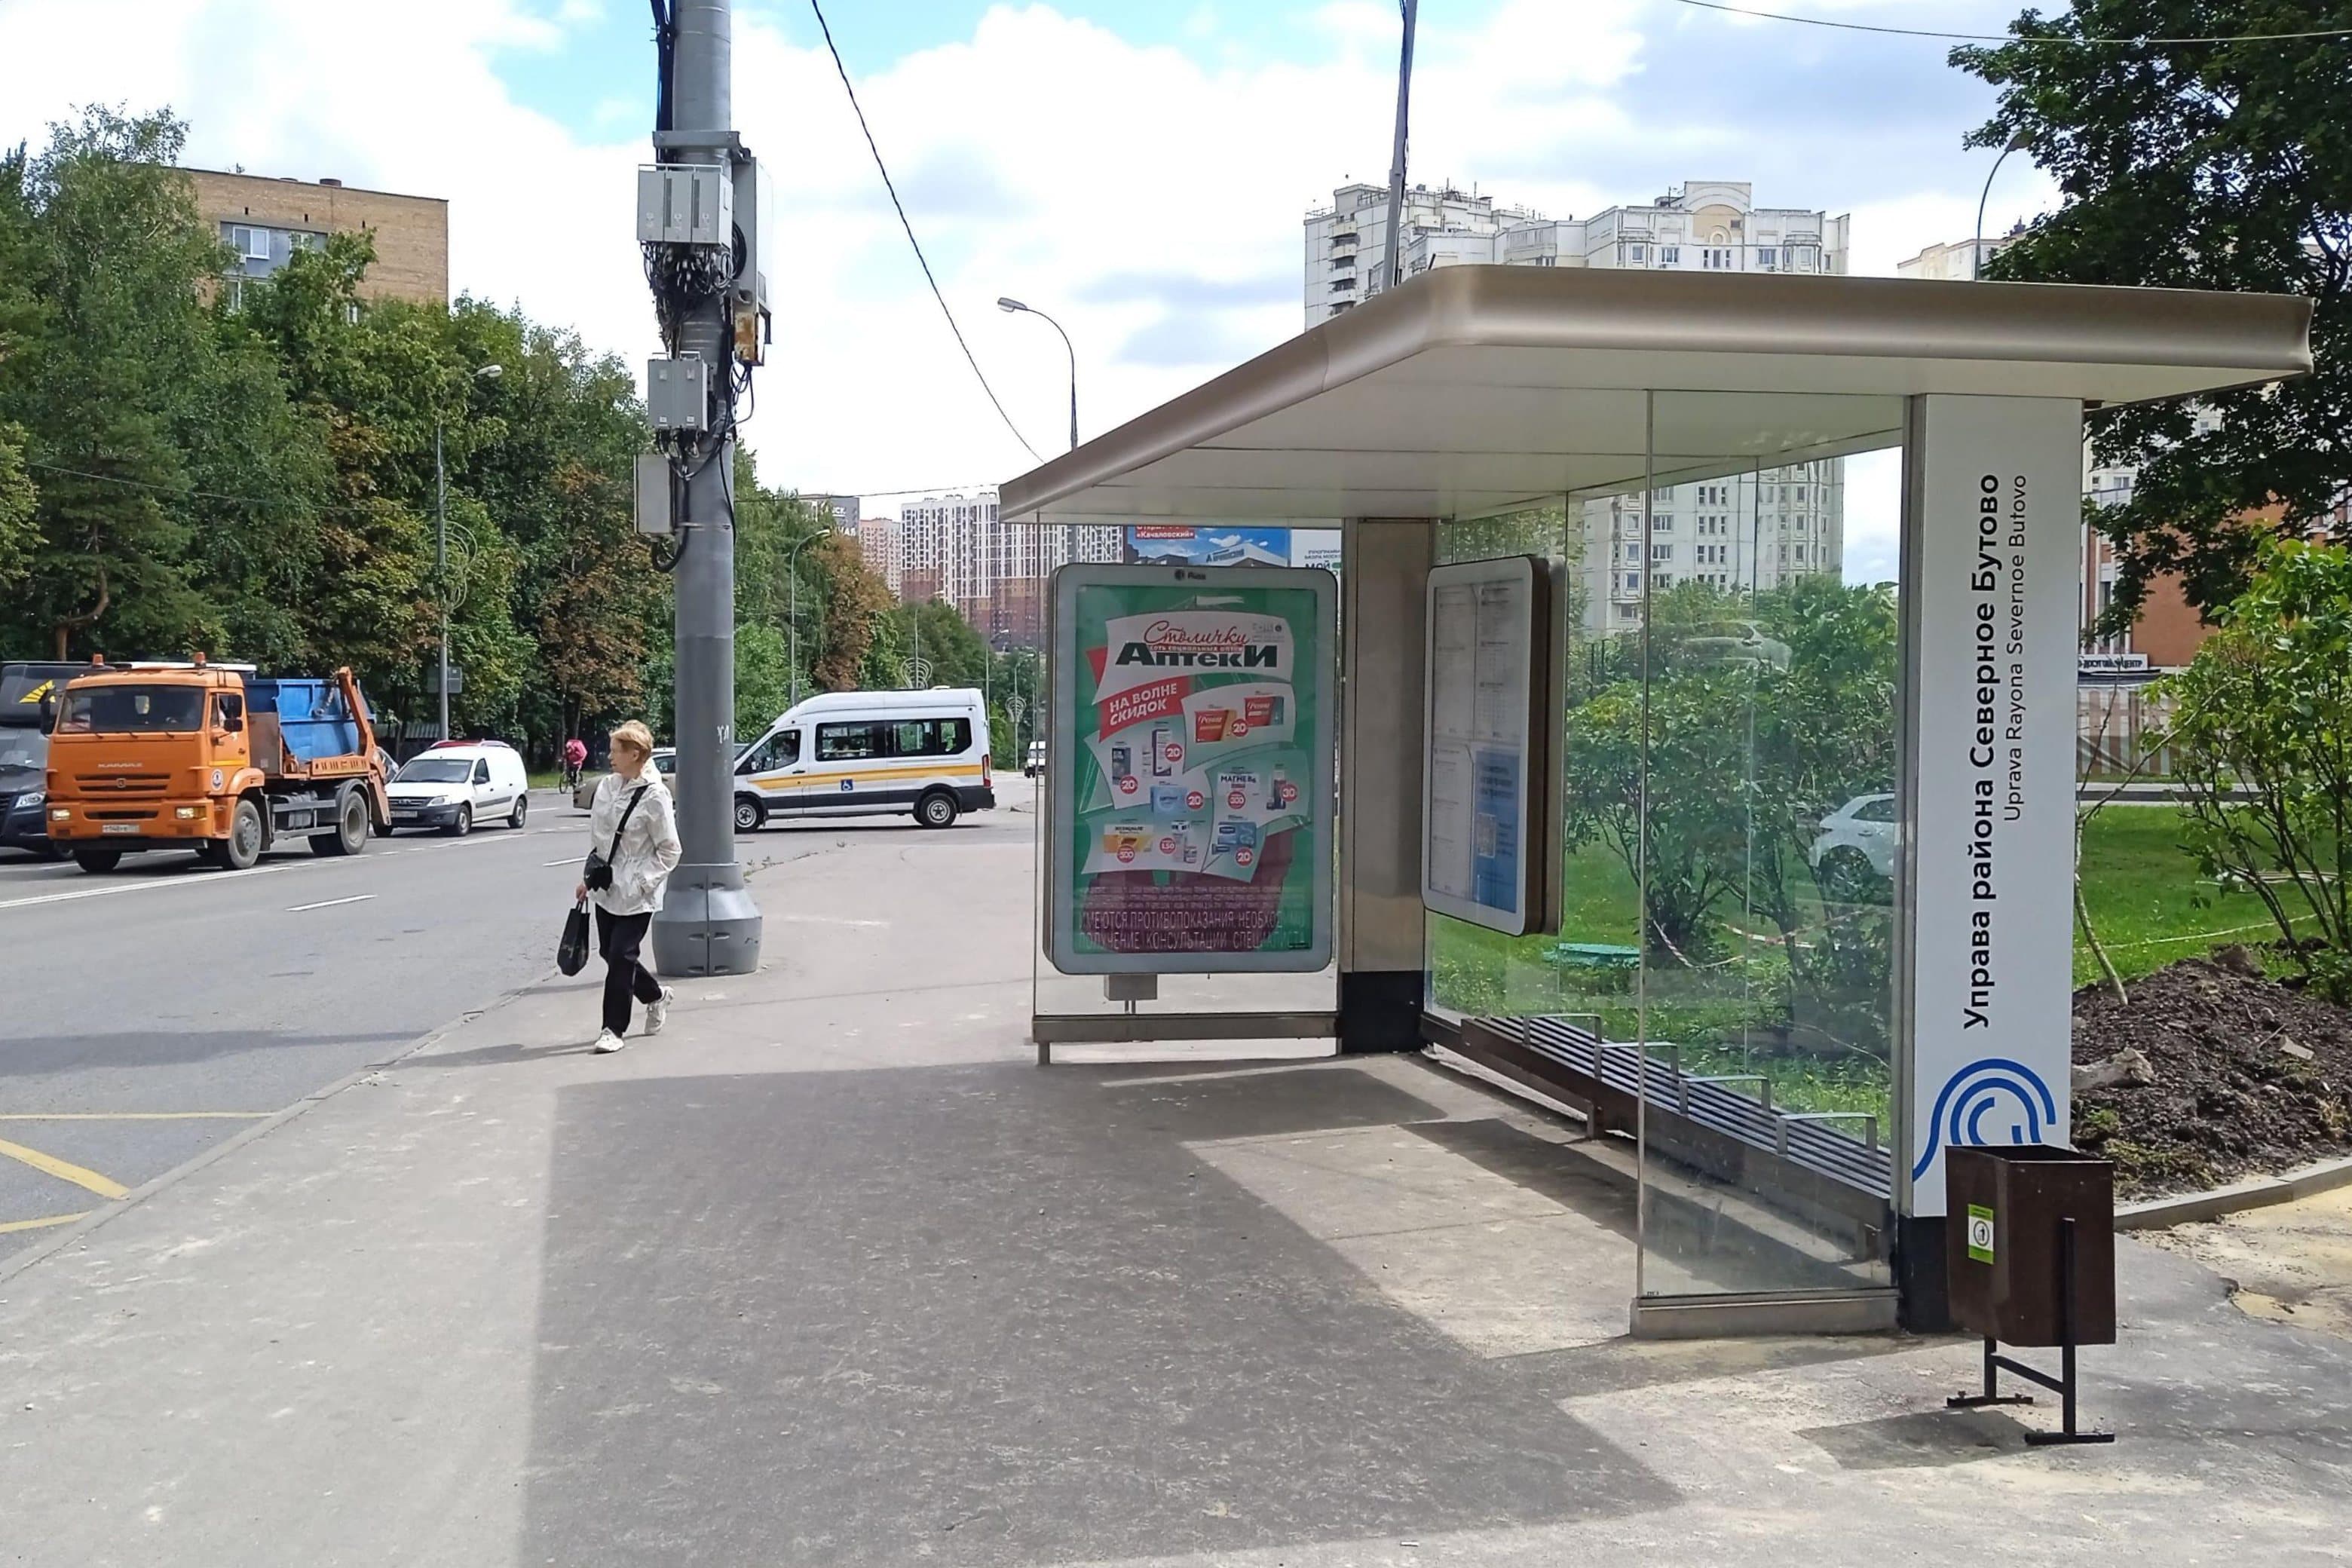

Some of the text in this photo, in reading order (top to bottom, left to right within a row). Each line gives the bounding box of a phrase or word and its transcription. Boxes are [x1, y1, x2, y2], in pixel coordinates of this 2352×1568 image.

[1144, 620, 1251, 646] Столички
[2004, 474, 2027, 821] Uprava Rayona Severnoe Butovo
[1110, 683, 1178, 713] НА ВОЛНЕ
[1110, 698, 1167, 727] СКИДОК
[1233, 723, 1247, 733] 20
[1166, 748, 1181, 758] 20
[1963, 474, 2003, 1030] Управа района Северное Бутово
[1121, 779, 1136, 790] 20
[1187, 795, 1202, 806] 20
[1237, 852, 1251, 862] 20
[1079, 911, 1128, 929] ИМЕЮТСЯ
[1079, 932, 1141, 950] ПОЛУЧЕНИЕ
[1146, 932, 1227, 950] КОНСУЛЬТАЦИИ
